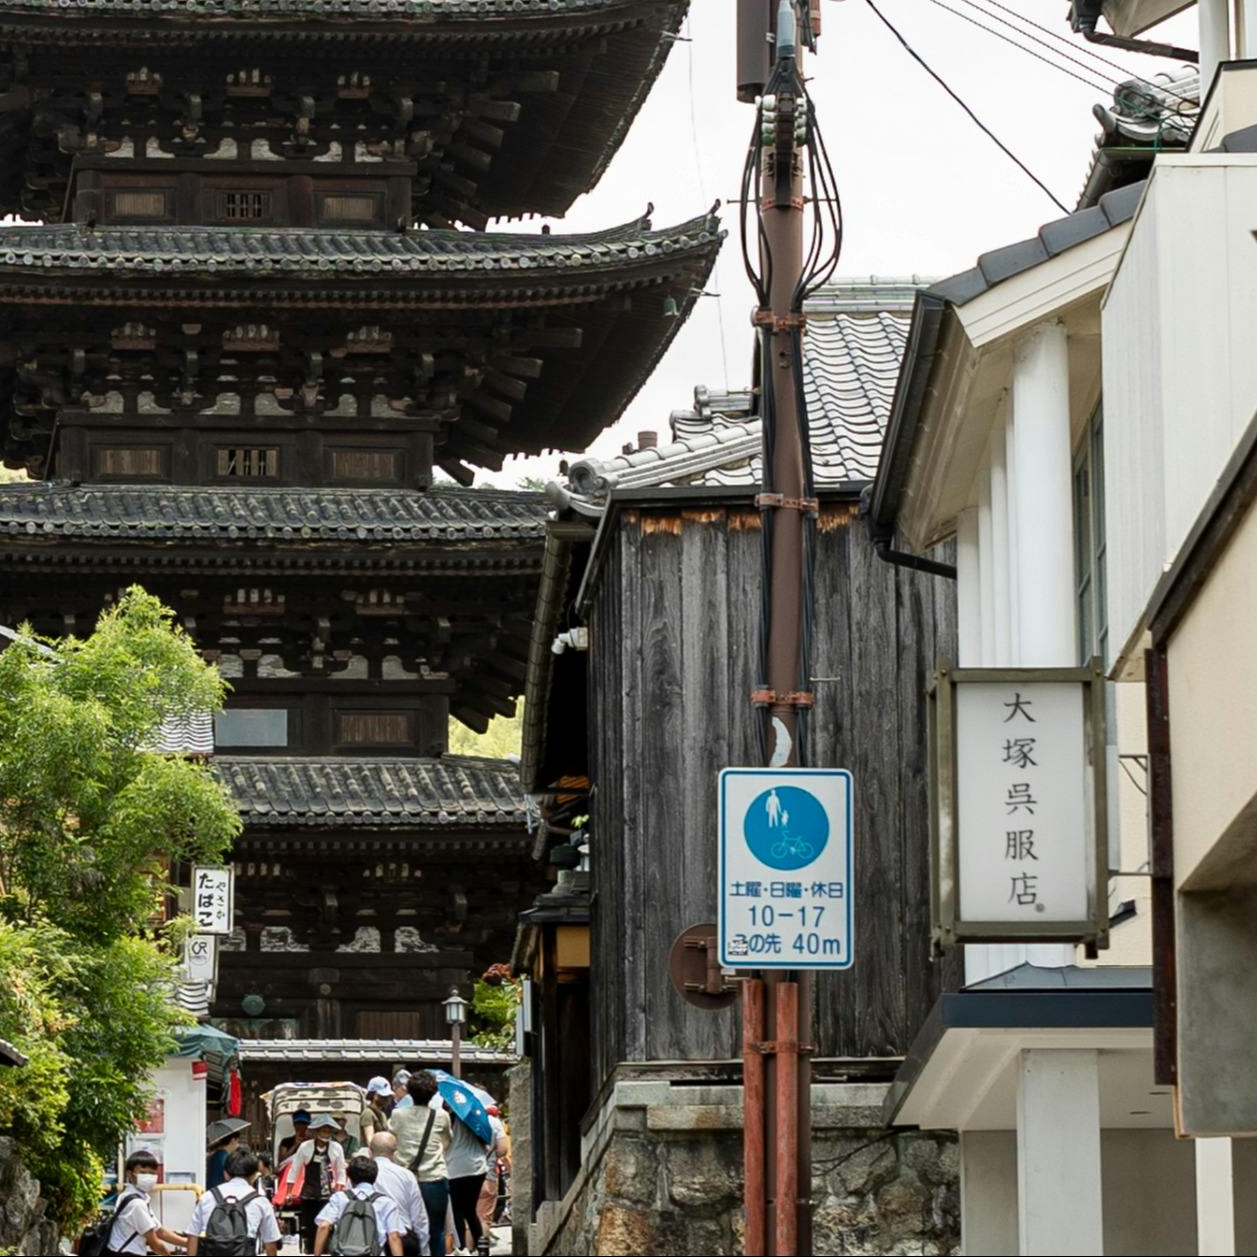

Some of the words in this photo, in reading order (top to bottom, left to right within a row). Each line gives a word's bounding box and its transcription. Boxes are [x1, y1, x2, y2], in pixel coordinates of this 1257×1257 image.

[1002, 693, 1039, 906] 大塚呉服店
[792, 933, 841, 955] 40m
